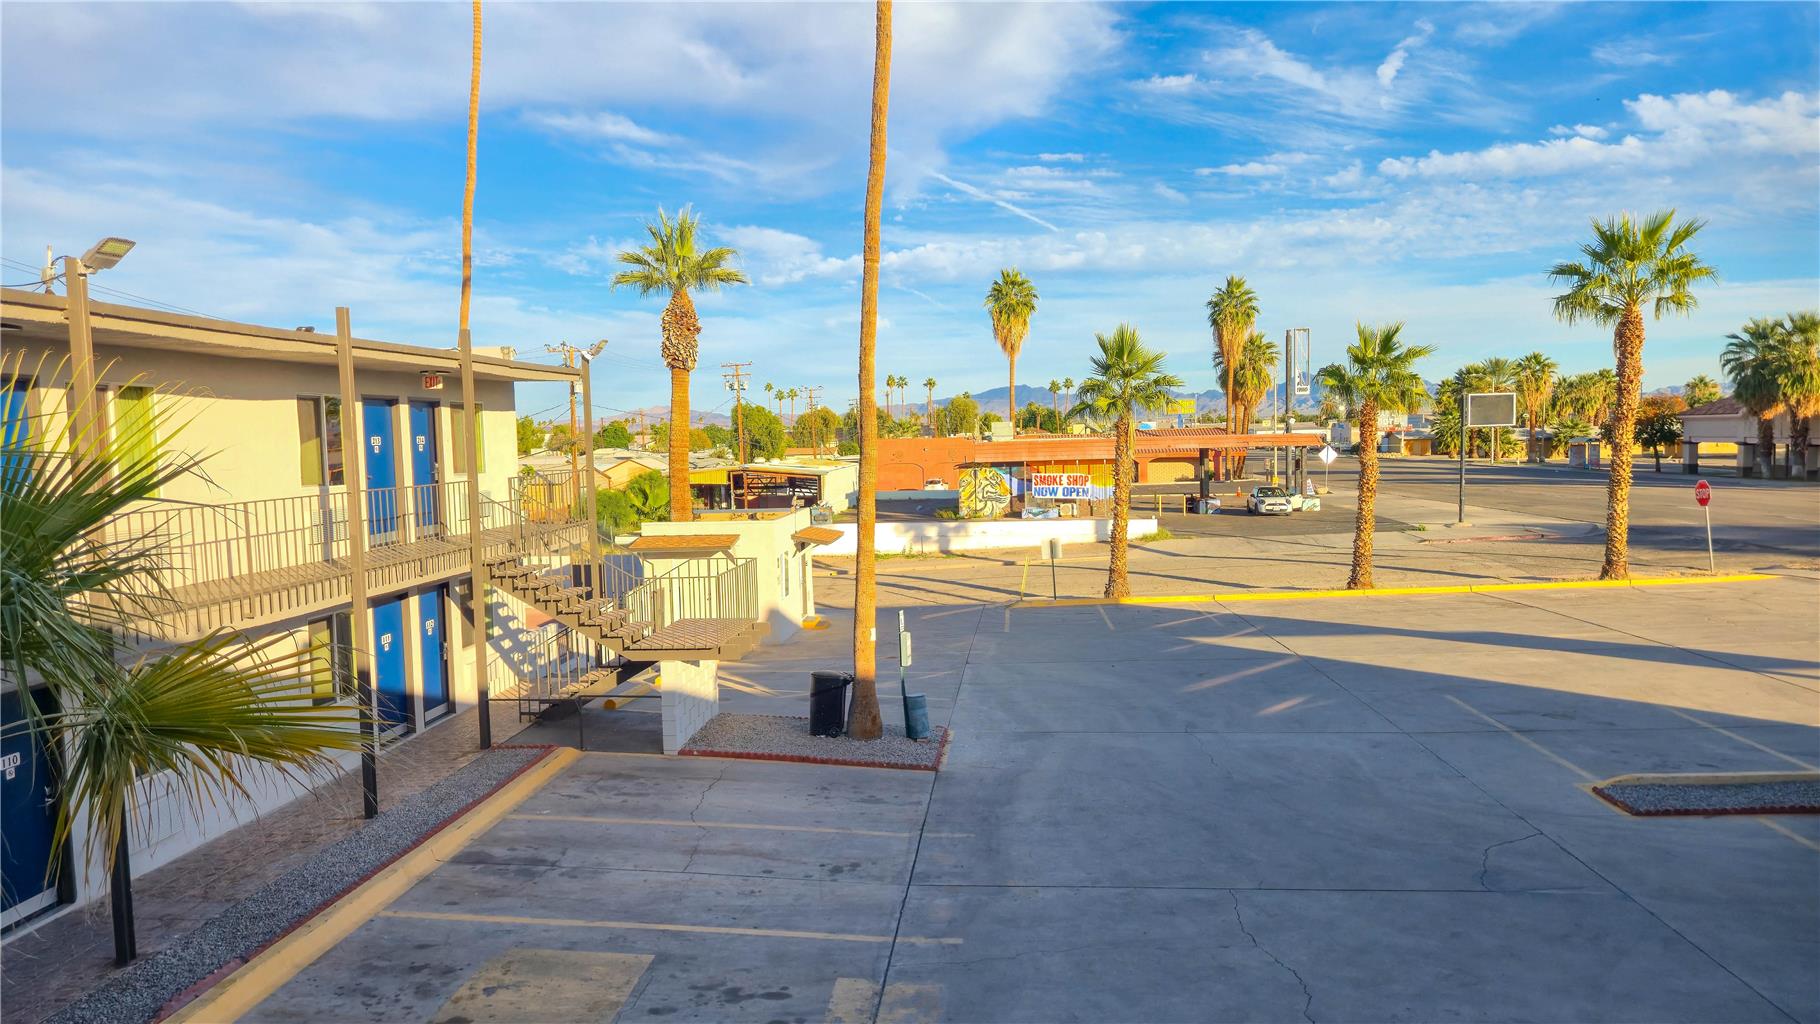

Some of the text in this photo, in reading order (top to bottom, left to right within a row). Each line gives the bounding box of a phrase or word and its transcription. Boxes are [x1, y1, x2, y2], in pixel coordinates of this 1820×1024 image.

[425, 376, 439, 388] EXIT
[1034, 475, 1089, 486] SMOKE SHOP
[1034, 487, 1089, 497] NOW OPEN
[1696, 489, 1709, 498] STOP
[2, 755, 18, 769] 110
